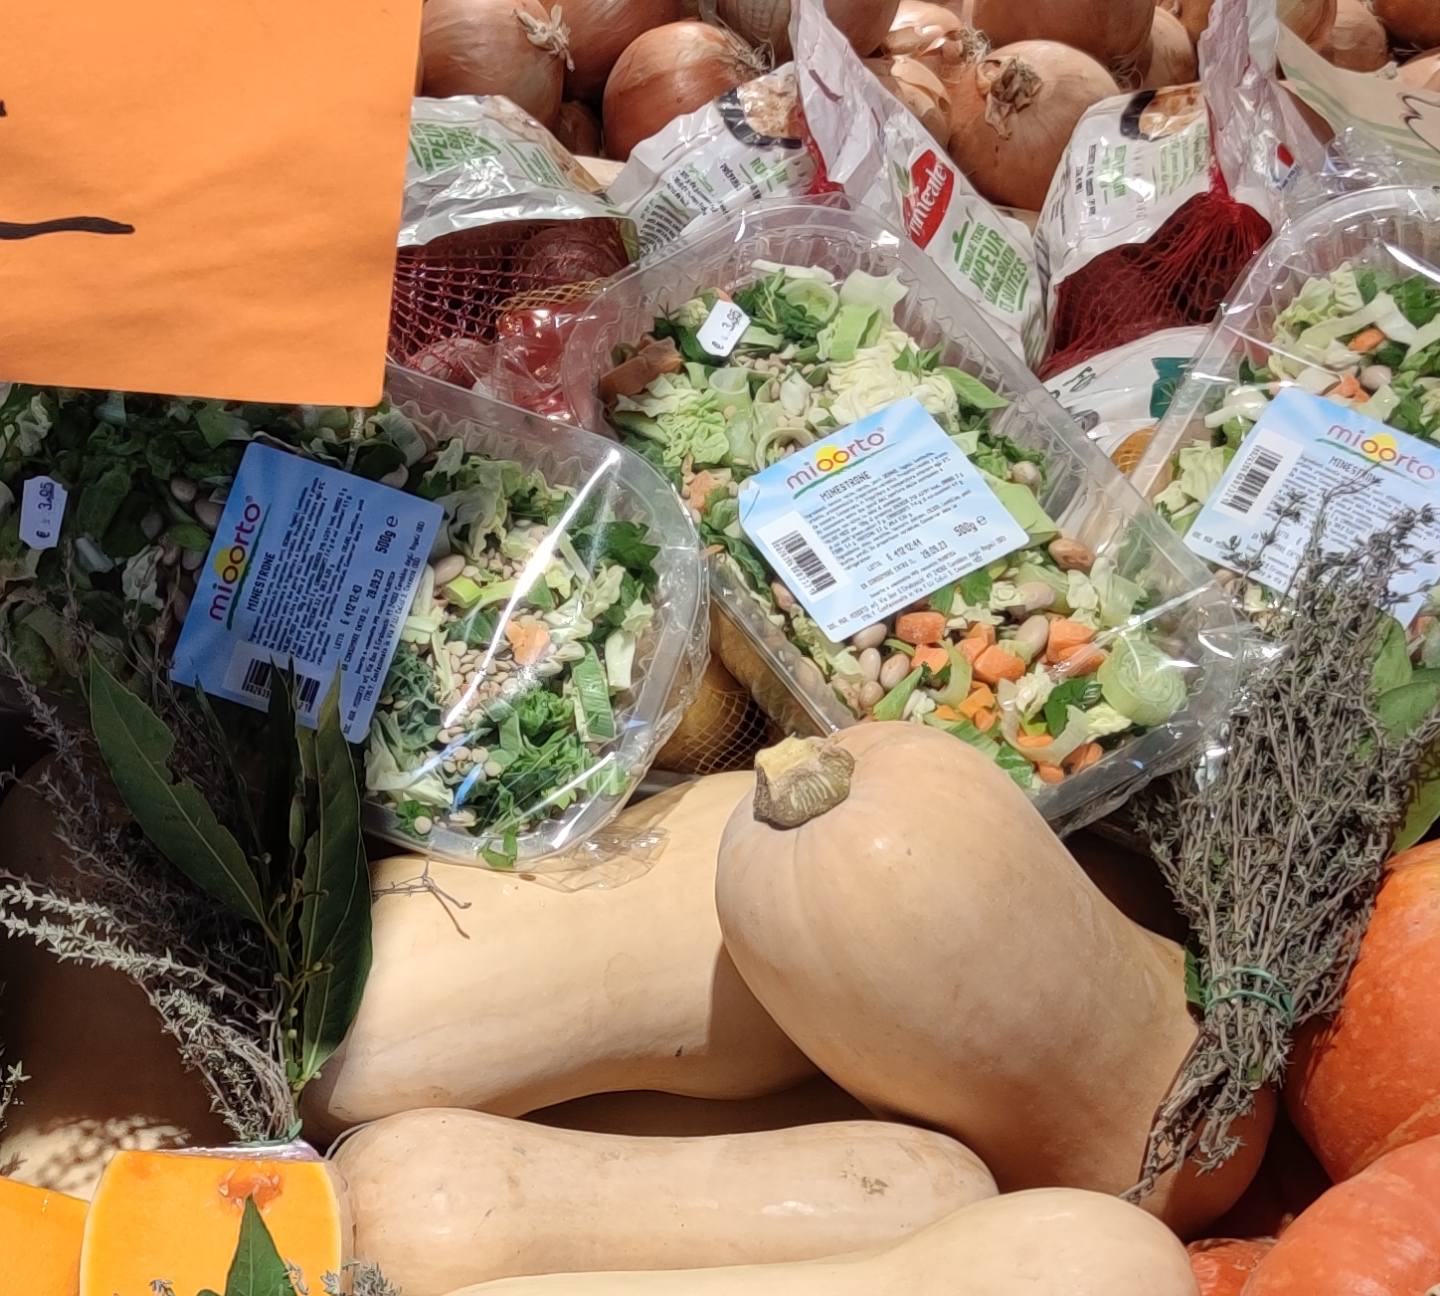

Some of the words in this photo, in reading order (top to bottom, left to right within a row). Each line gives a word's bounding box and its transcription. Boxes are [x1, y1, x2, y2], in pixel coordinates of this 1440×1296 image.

[969, 229, 1006, 293] VAPEUR
[786, 428, 884, 488] mioorto
[1327, 424, 1434, 479] mioorto
[819, 470, 871, 501] MINESTRONE
[374, 529, 396, 554] 500g
[953, 521, 978, 537] 500g
[209, 500, 260, 620] mioorto
[246, 552, 275, 611] MINESTRONE
